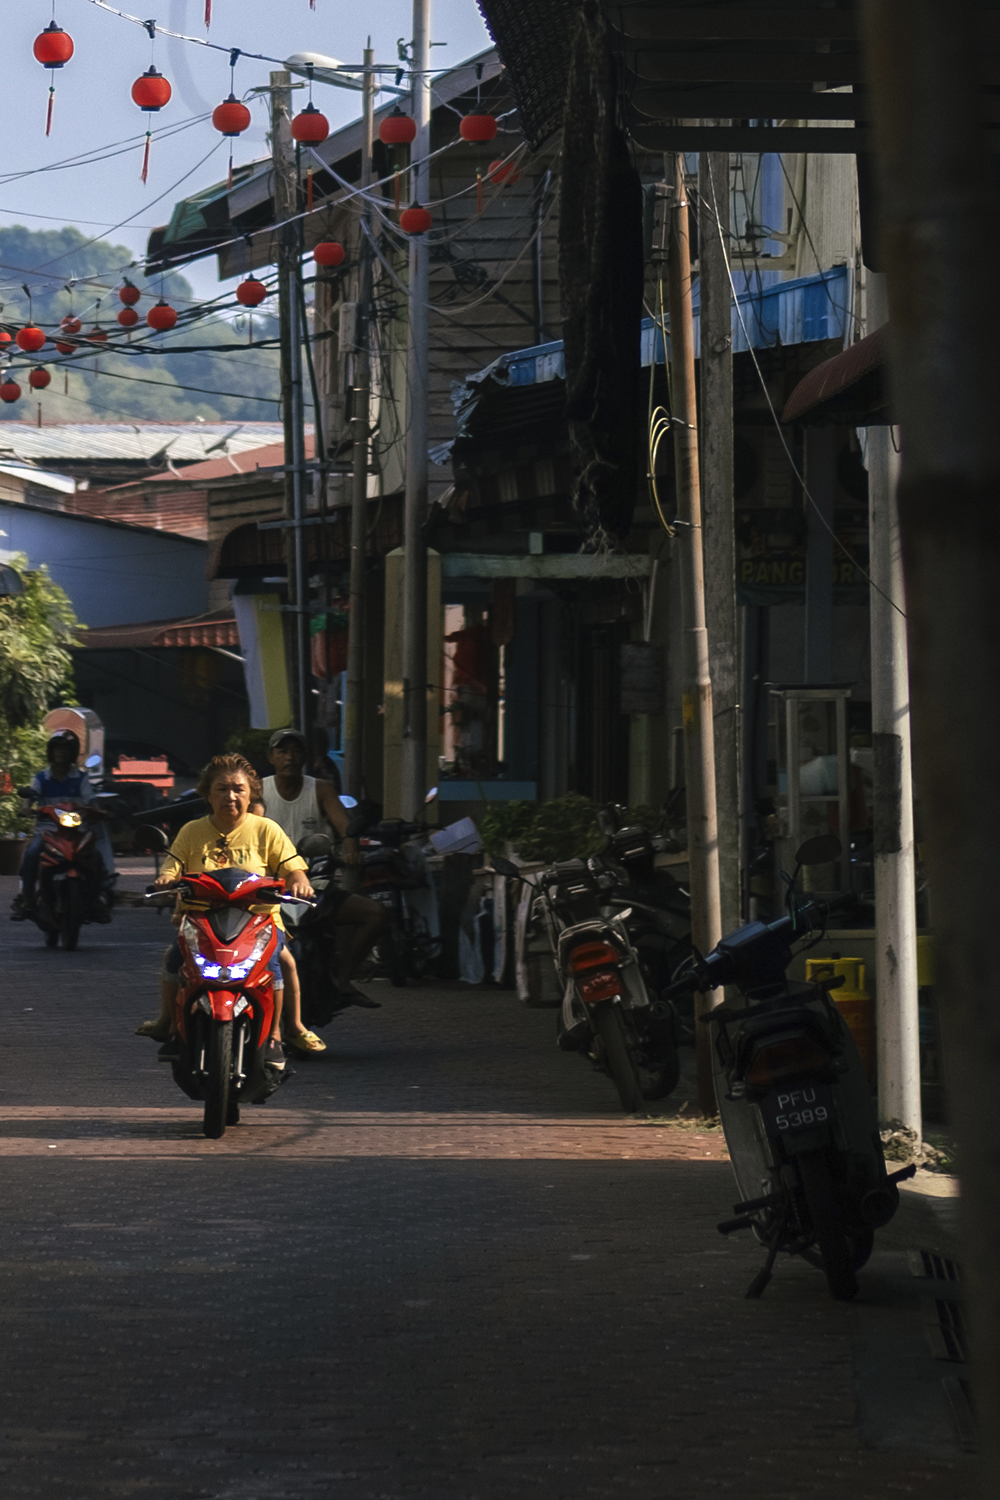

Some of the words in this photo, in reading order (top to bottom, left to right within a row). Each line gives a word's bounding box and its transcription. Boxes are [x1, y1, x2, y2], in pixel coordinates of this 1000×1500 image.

[741, 561, 854, 585] PANGR
[777, 1088, 816, 1109] PFU
[776, 1106, 828, 1129] 5389
